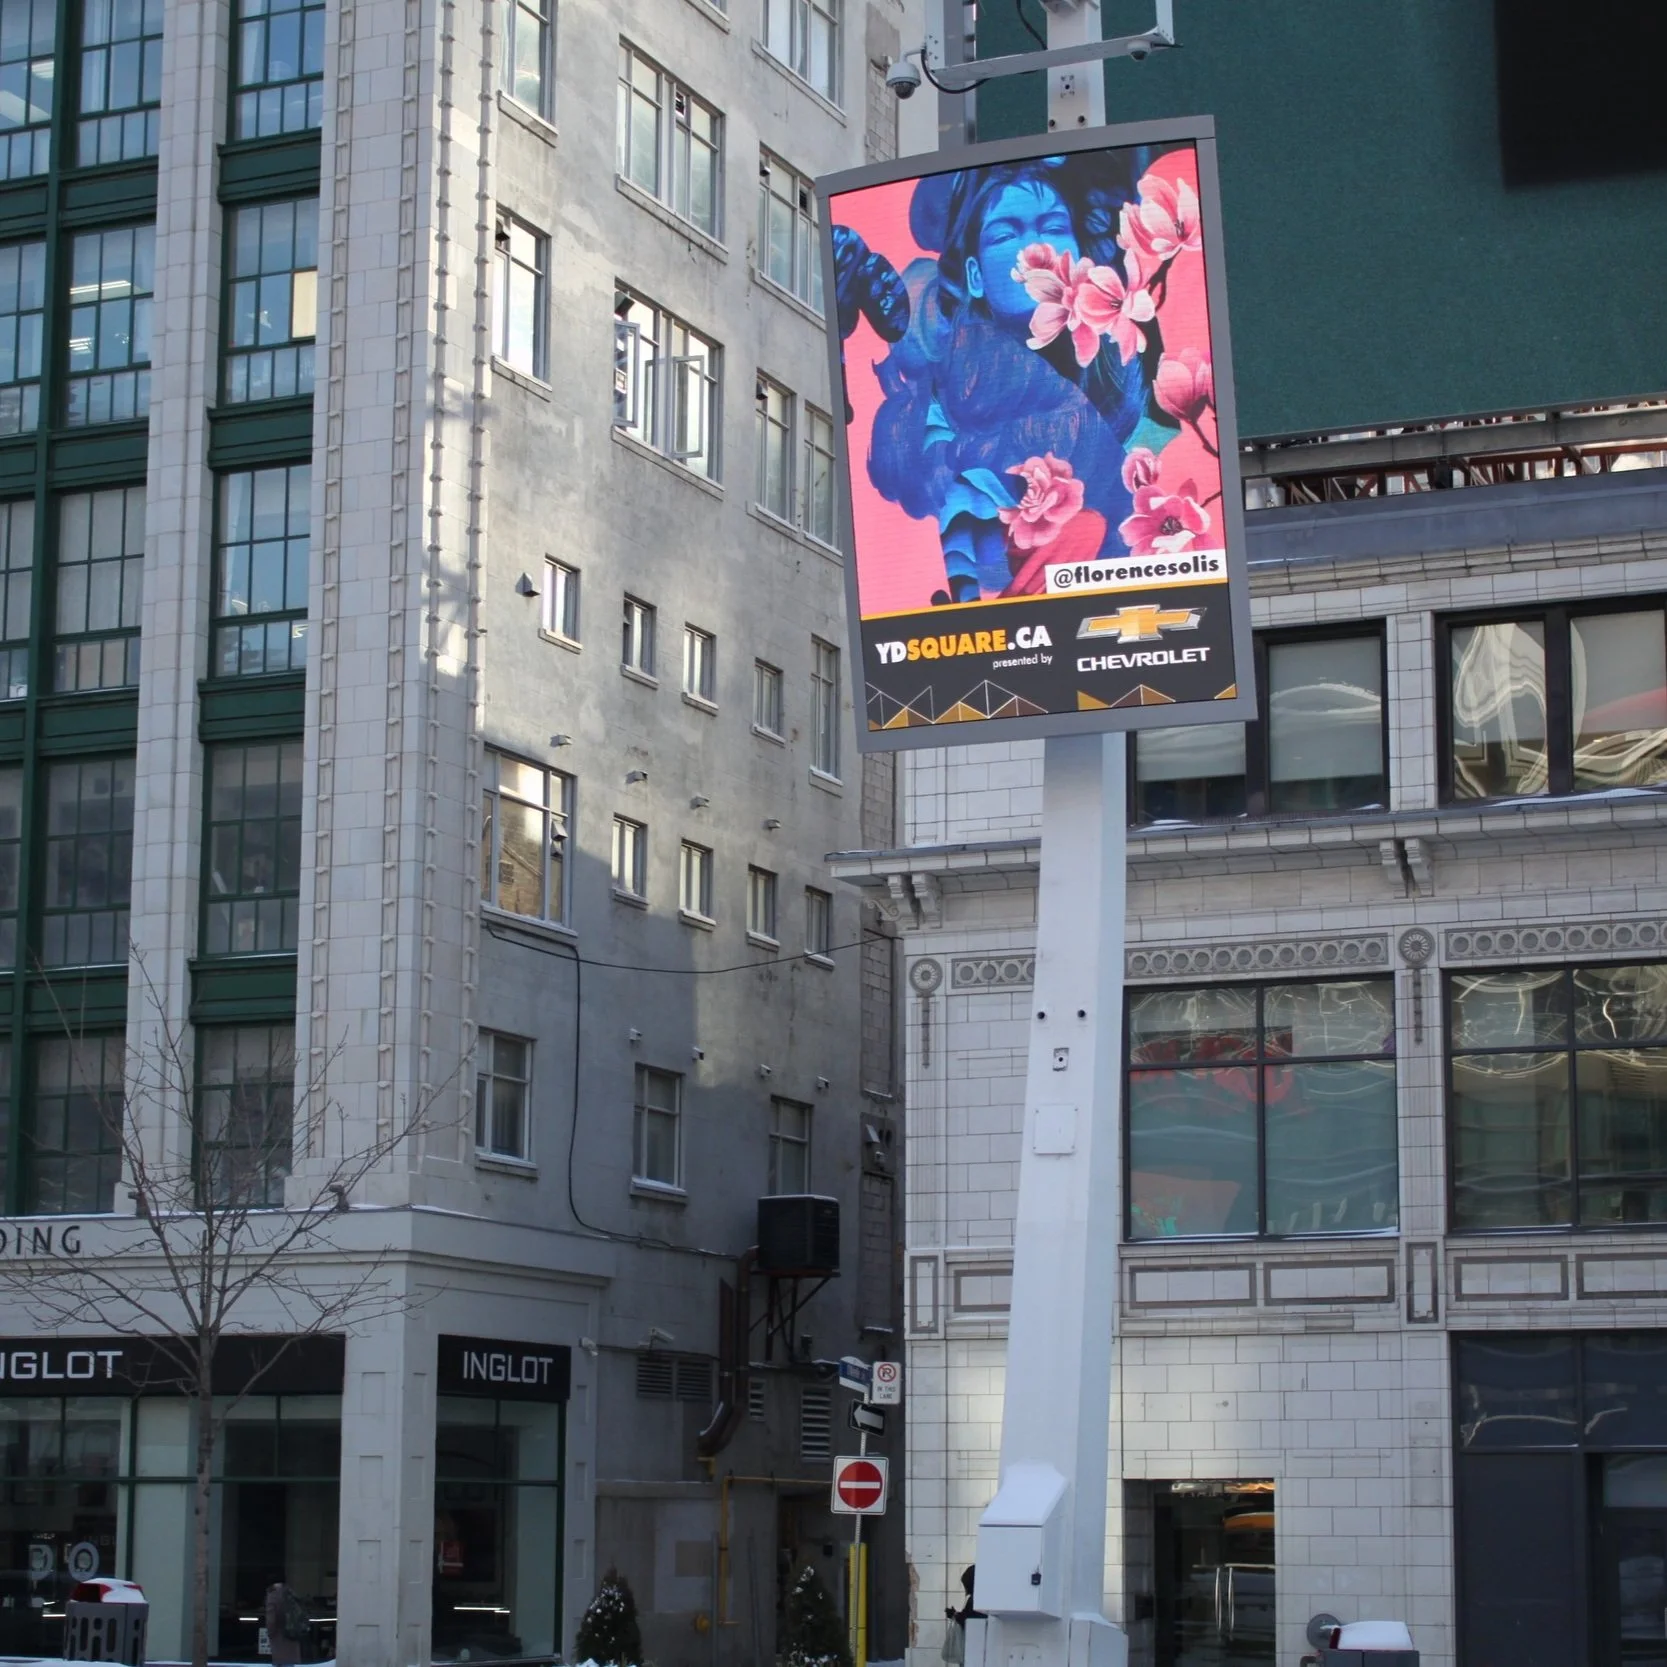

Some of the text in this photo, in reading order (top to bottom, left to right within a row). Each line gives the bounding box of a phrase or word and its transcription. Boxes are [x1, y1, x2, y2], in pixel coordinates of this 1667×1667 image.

[1053, 556, 1220, 588] @florencesolis
[874, 625, 1053, 665] YDSQUARE.CA
[1077, 647, 1211, 672] CHEVROLET
[992, 653, 1054, 671] presented by
[0, 1350, 124, 1380] GLOT
[463, 1351, 554, 1385] INGLOT
